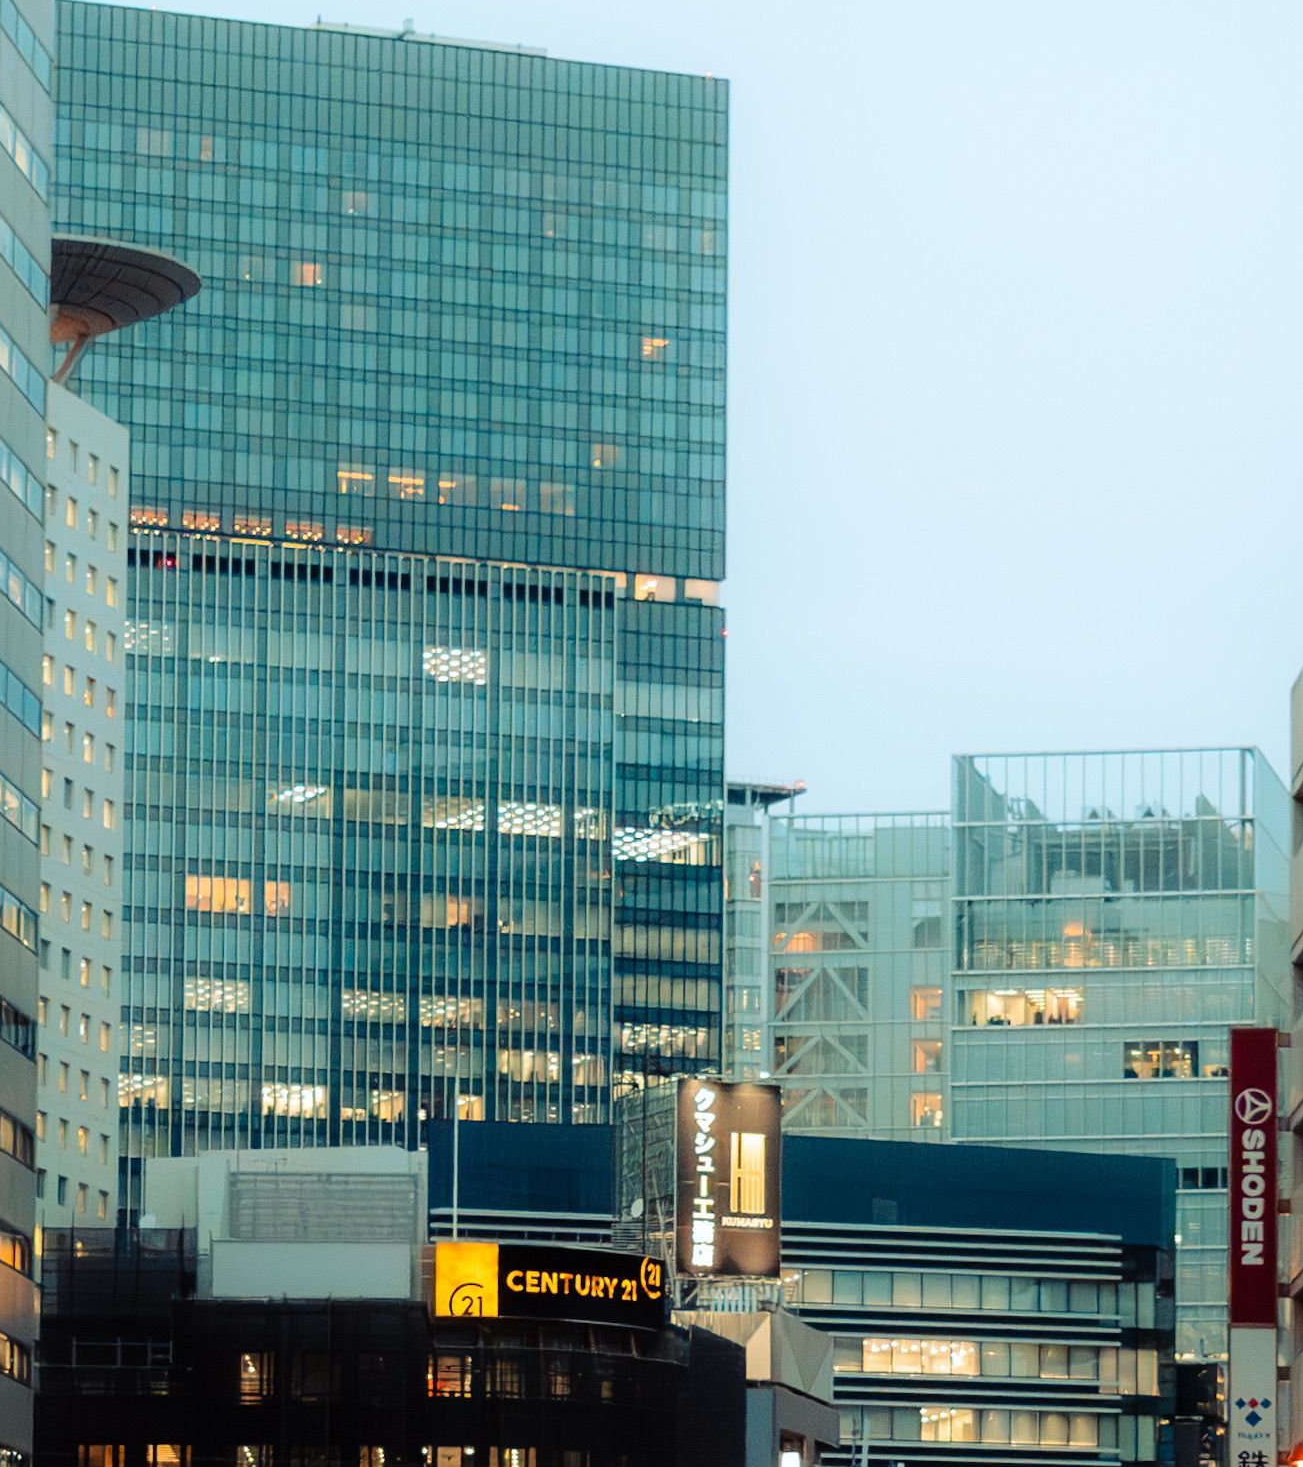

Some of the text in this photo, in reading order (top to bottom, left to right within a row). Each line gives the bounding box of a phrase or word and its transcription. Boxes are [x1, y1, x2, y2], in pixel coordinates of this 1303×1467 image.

[1241, 1128, 1266, 1266] SHODEN
[506, 1270, 638, 1301] CENTURY 21
